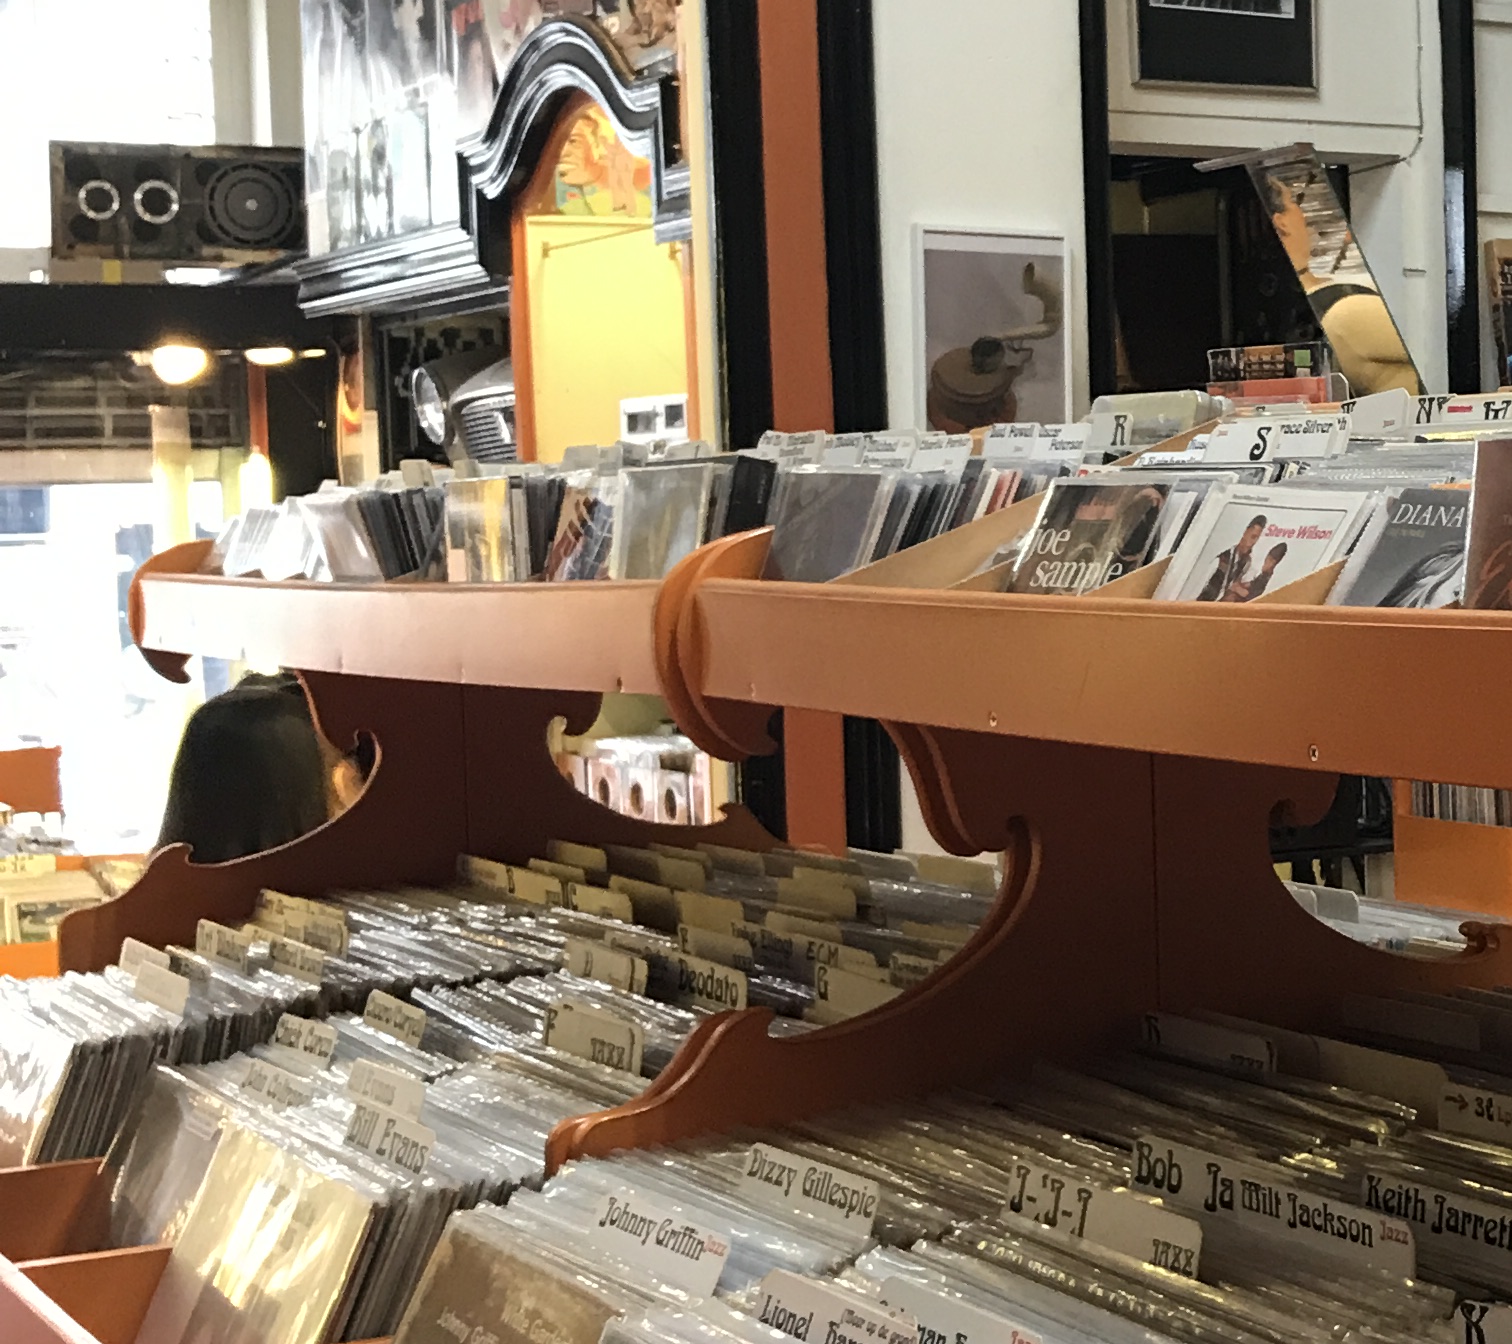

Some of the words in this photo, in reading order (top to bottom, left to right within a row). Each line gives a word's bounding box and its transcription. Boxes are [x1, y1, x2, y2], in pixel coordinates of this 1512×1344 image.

[1110, 414, 1128, 446] R
[1249, 426, 1272, 461] S
[1031, 518, 1071, 557] joe
[1266, 523, 1295, 539] Steve
[1296, 524, 1333, 540] Wilson
[1391, 502, 1466, 528] DIANA
[1029, 558, 1122, 592] sample
[375, 1117, 430, 1175] Evans
[1133, 1139, 1184, 1196] Bob
[745, 1148, 798, 1196] Dizzy
[799, 1166, 878, 1219] Gillespie
[1364, 1173, 1426, 1225] Keith
[597, 1195, 658, 1246] Johnny
[654, 1218, 705, 1263] Griffin
[1240, 1178, 1283, 1221] Milt
[1286, 1192, 1375, 1251] Jackson
[758, 1294, 815, 1343] Lionel
